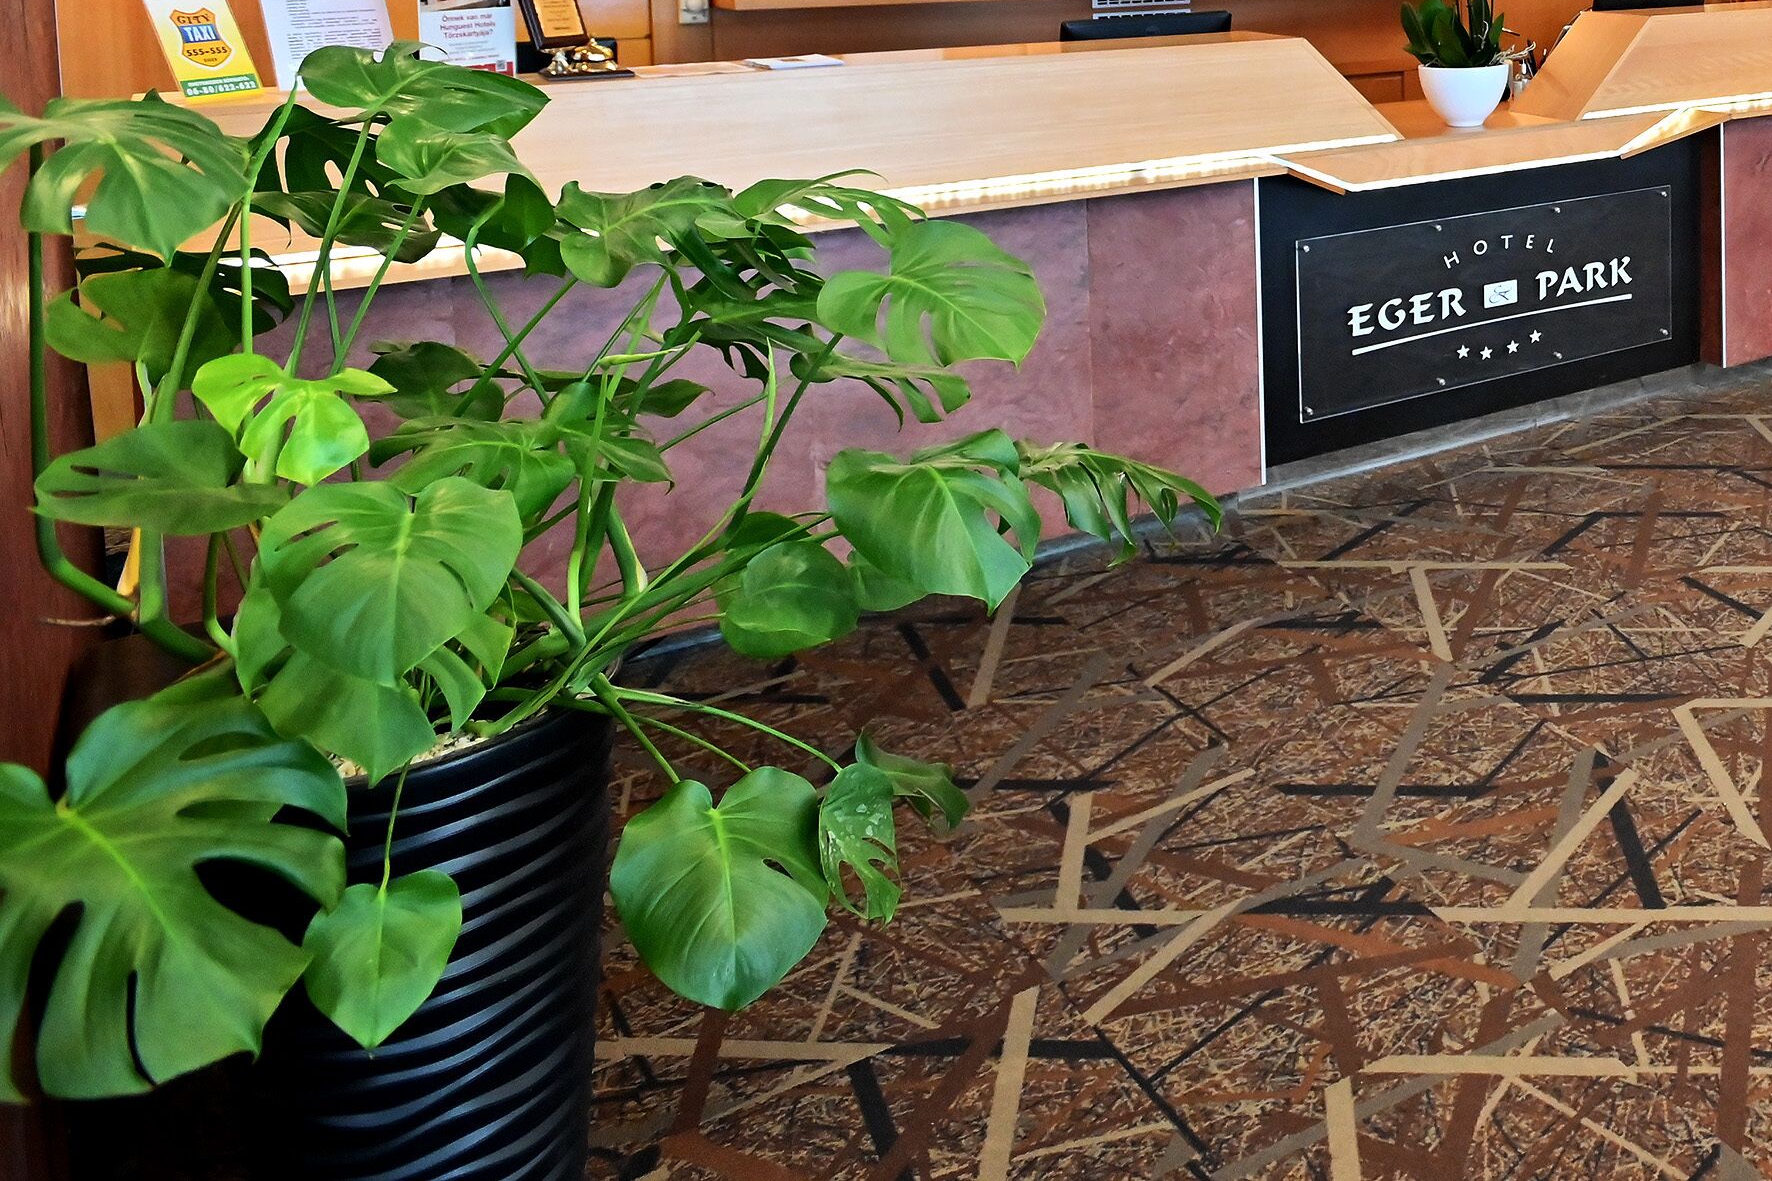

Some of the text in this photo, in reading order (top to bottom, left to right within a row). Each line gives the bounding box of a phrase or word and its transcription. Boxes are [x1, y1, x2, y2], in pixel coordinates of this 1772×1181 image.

[184, 25, 217, 42] TAXI
[186, 46, 228, 57] 555-555
[1443, 233, 1554, 269] HOTEL
[1347, 288, 1467, 337] EGER
[1535, 255, 1633, 301] PARK
